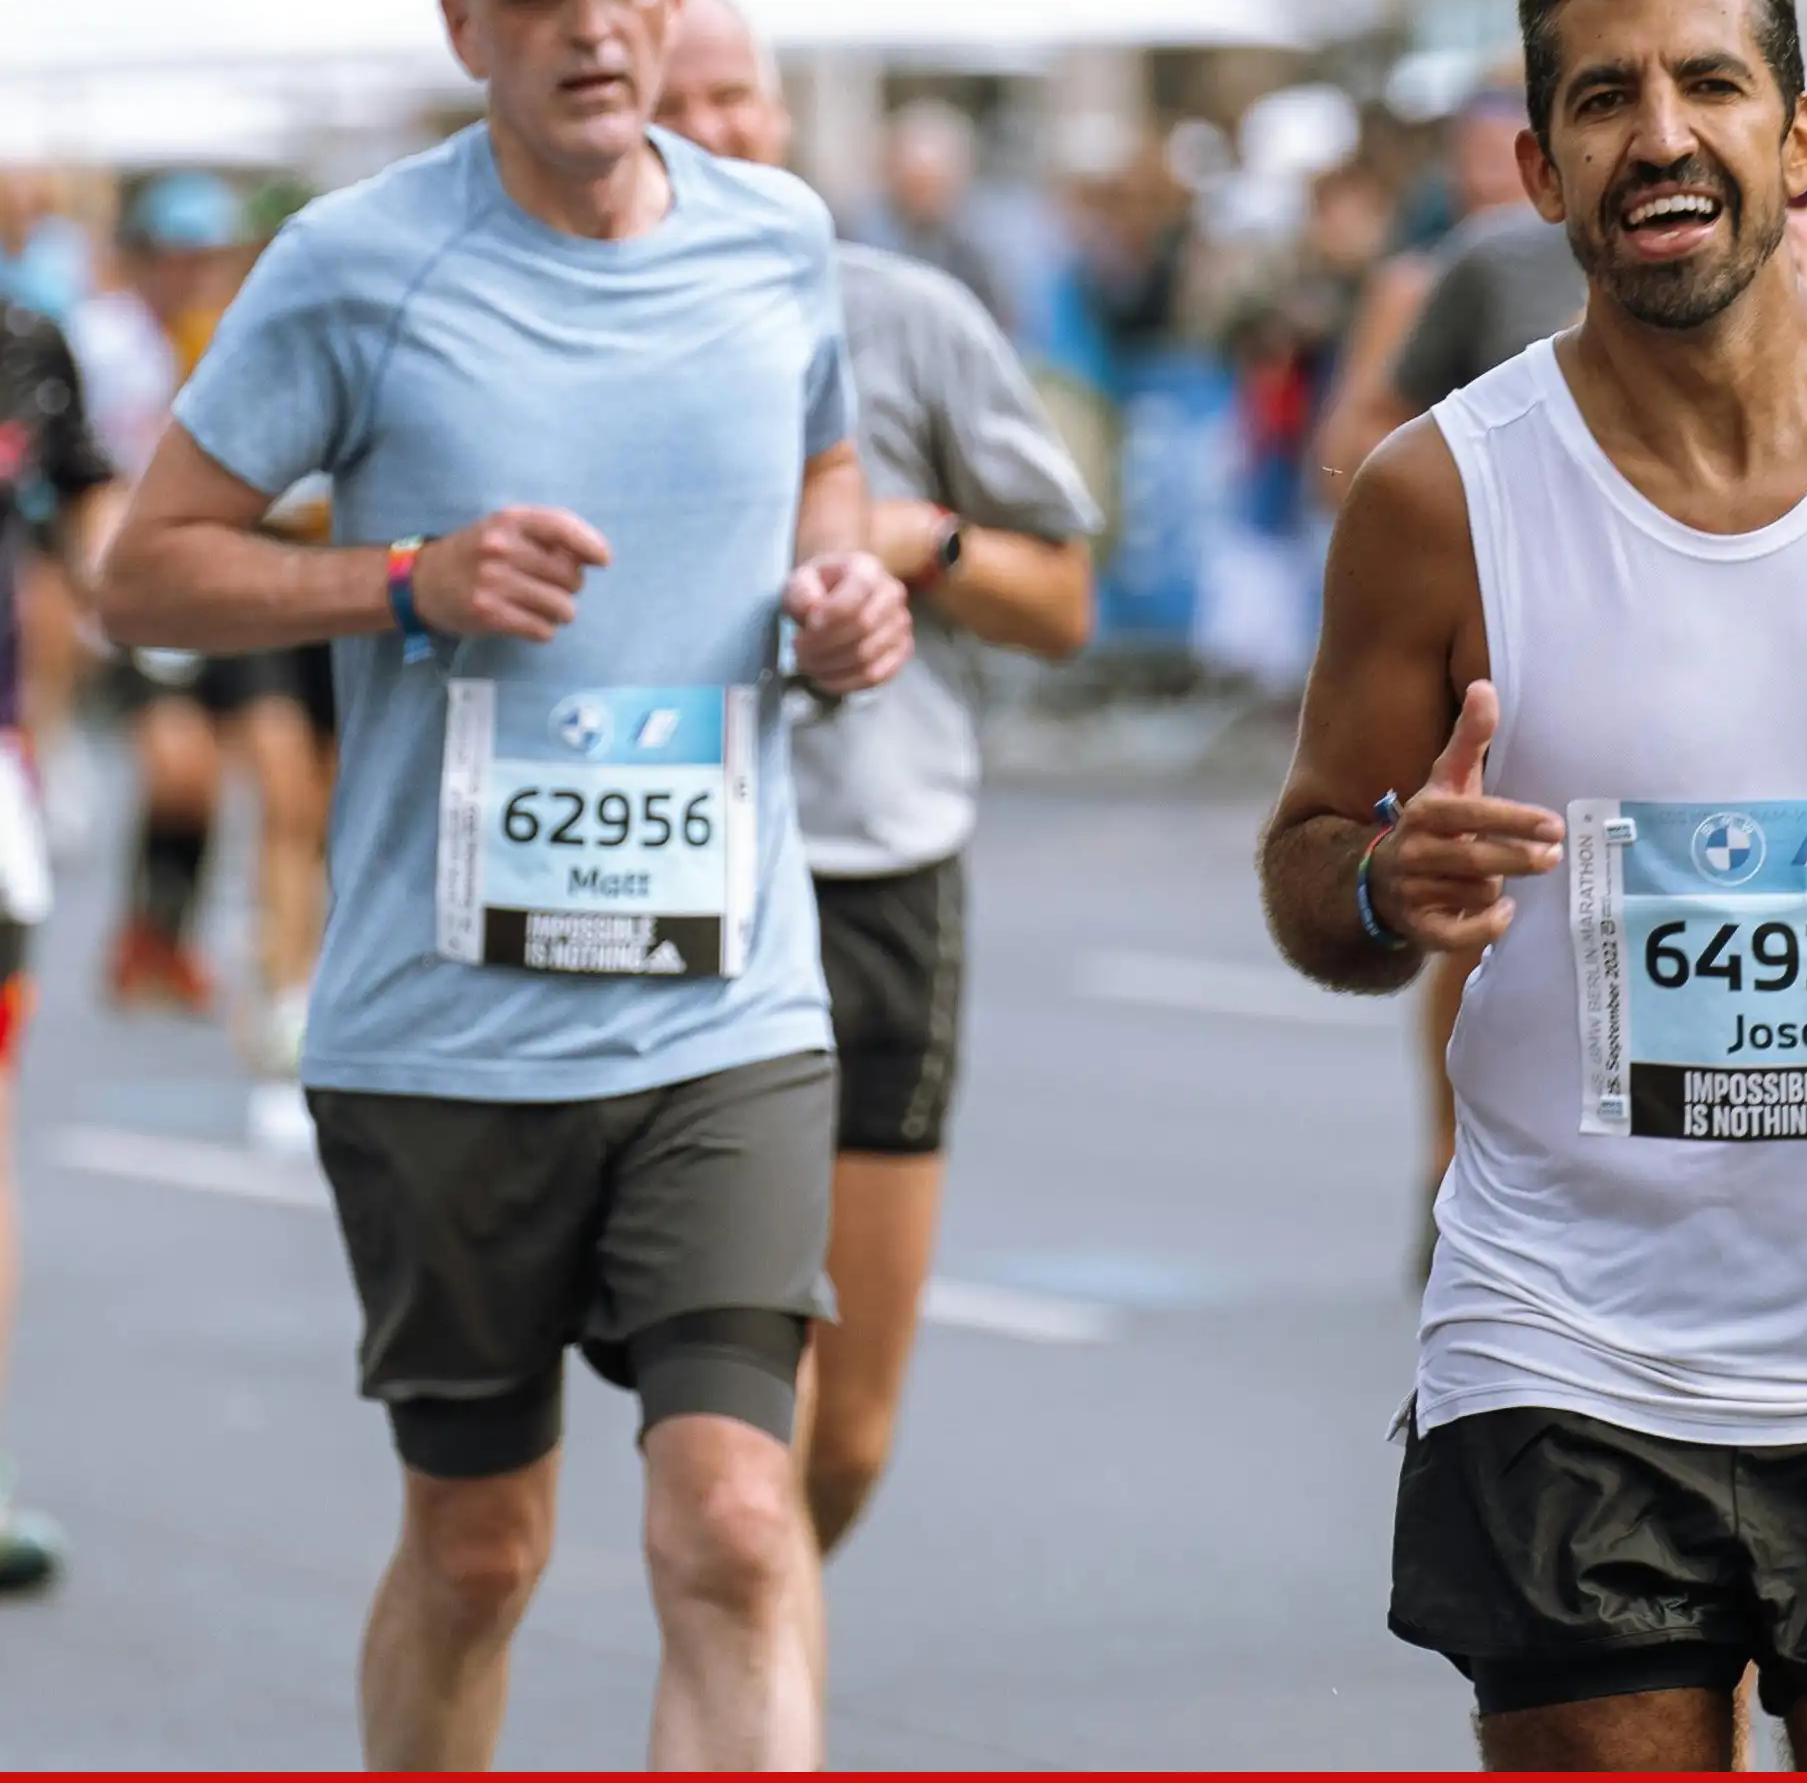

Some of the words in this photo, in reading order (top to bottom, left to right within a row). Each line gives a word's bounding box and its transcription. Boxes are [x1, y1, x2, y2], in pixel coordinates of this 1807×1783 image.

[503, 789, 711, 848] 62956
[567, 867, 651, 898] Matt
[1602, 939, 1619, 979] 2022
[1605, 983, 1623, 1071] September
[1683, 1103, 1708, 1136] IS
